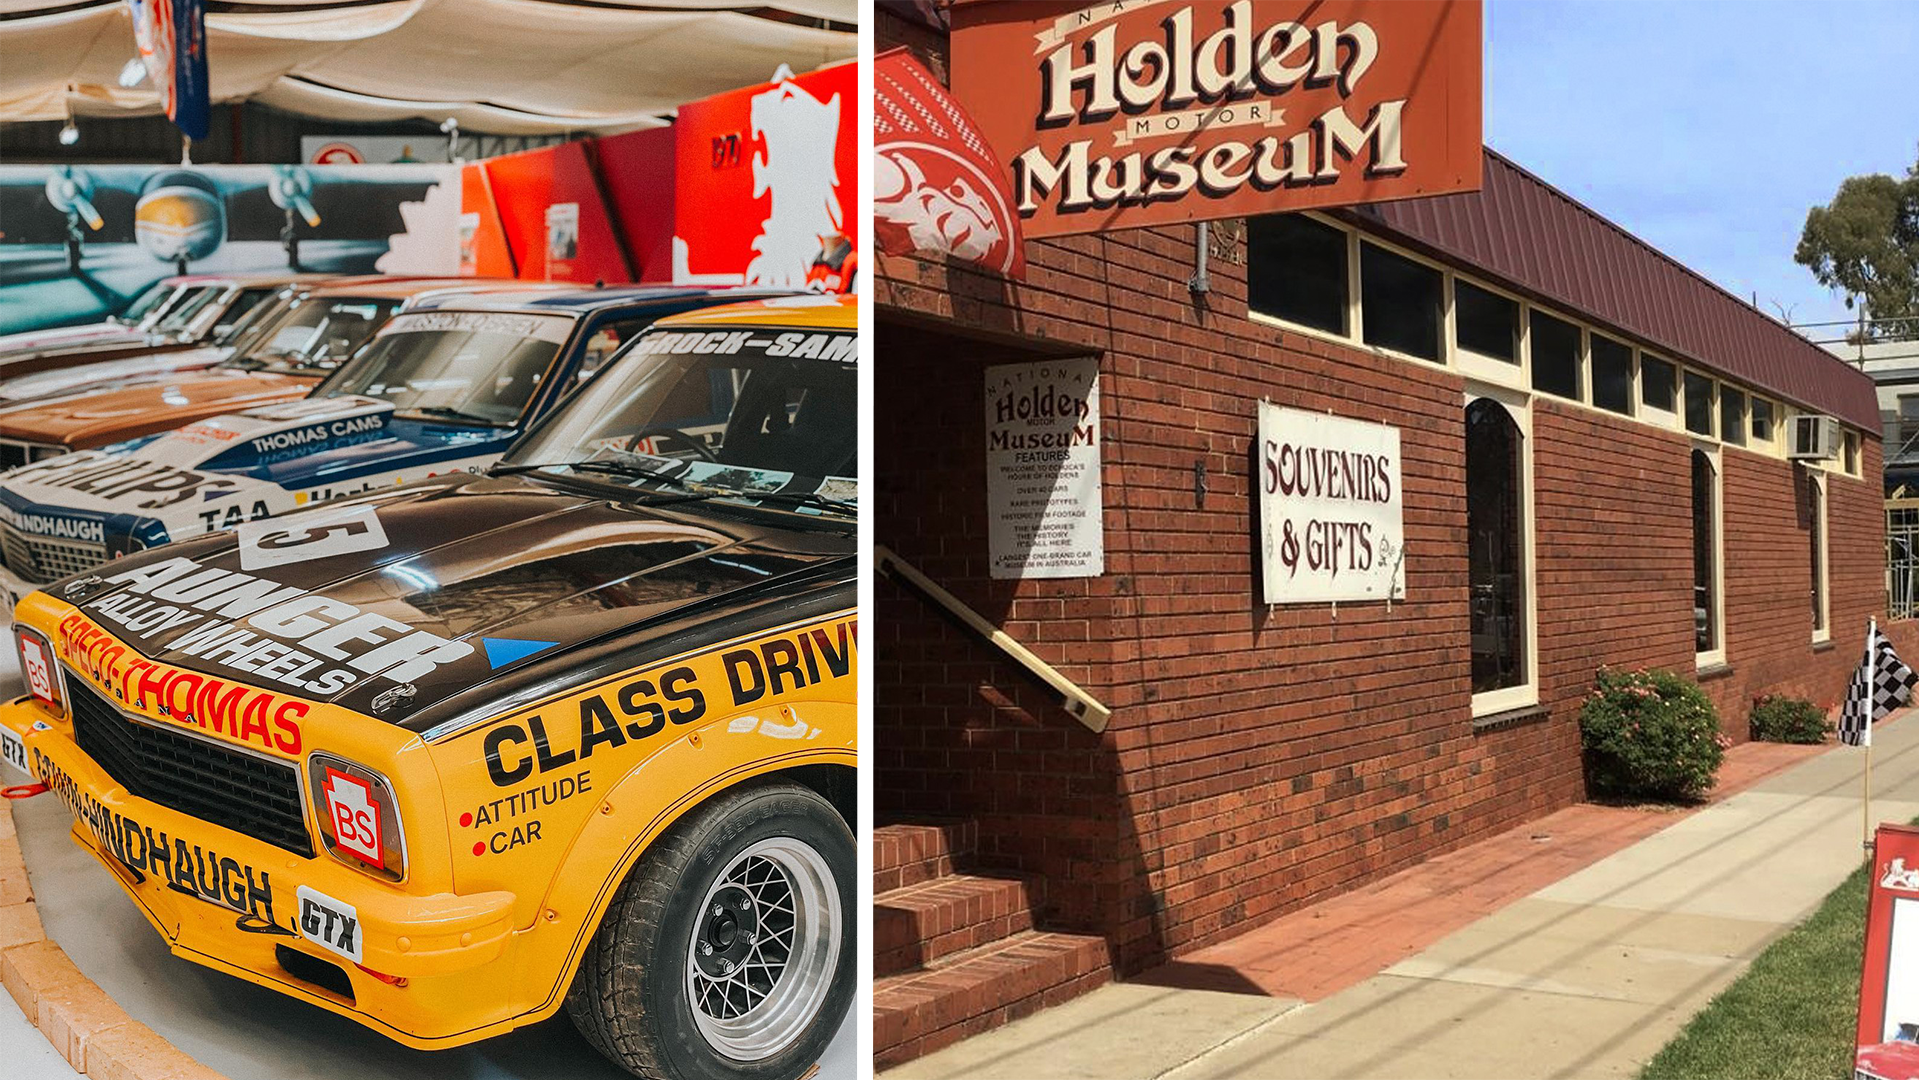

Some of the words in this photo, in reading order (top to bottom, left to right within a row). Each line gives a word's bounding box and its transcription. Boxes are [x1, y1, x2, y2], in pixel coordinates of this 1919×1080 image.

[1036, 0, 1379, 129] Holden
[1136, 106, 1263, 134] MOTOR
[996, 384, 1089, 423] Holden
[252, 424, 329, 453] THOMAS
[331, 414, 384, 438] CAMS
[1027, 418, 1055, 426] MOTOR
[1000, 464, 1035, 473] WELCOME
[1037, 464, 1048, 472] TO
[1015, 449, 1071, 463] FEATURES
[1265, 440, 1391, 504] SOUVENIRS
[1007, 473, 1032, 481] HOUSE
[1033, 472, 1044, 480] OF
[1045, 471, 1079, 480] HOLDENS
[1016, 486, 1038, 494] OVER
[1048, 485, 1068, 493] CARS
[199, 500, 271, 532] TAA
[1001, 512, 1033, 520] HISTORIC
[1052, 510, 1087, 518] FOOTAGE
[1010, 500, 1030, 508] RARE
[1032, 498, 1079, 507] PROTOTYPES
[257, 519, 368, 549] 5
[1014, 525, 1030, 533] THE
[1033, 540, 1048, 548] ALL
[1049, 539, 1072, 547] HERE
[1034, 531, 1068, 540] HISTORY
[998, 553, 1031, 562] LARGEST
[1076, 551, 1093, 559] CAR
[1004, 561, 1036, 569] MUSEUM
[1045, 559, 1086, 568] AUSTRALIA
[1281, 518, 1300, 580] &
[1306, 518, 1373, 580] GIFTS
[104, 557, 475, 684] AUNGER
[97, 593, 203, 640] ALLOY
[164, 619, 357, 695] WHEELS
[29, 658, 49, 693] BS
[60, 614, 310, 755] SPECO-THOMAS
[483, 666, 706, 788] CLASS
[721, 620, 858, 707] DRIV
[1, 731, 27, 769] GTX
[473, 769, 593, 828] ATTITUDE
[337, 801, 376, 849] BS
[488, 819, 542, 855] CAR
[301, 897, 358, 955] GTX
